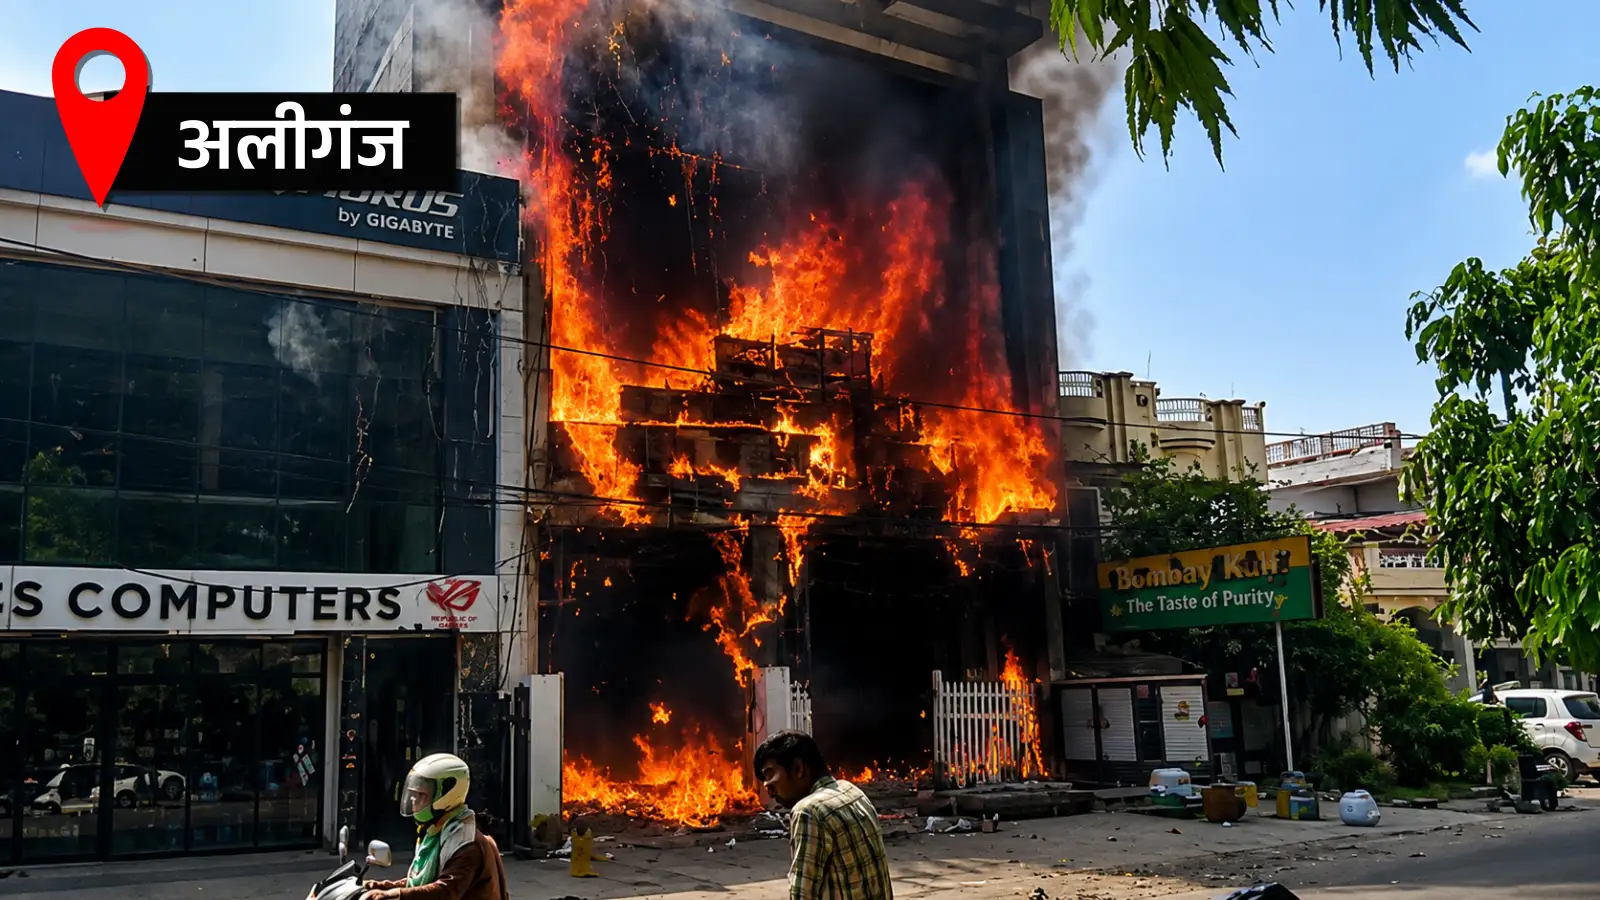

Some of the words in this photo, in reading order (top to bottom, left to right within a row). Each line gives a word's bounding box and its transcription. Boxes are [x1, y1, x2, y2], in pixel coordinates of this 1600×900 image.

[338, 207, 361, 227] by
[366, 213, 455, 239] GIGABYTE
[1116, 556, 1214, 590] Bombay
[0, 581, 43, 617] S
[68, 582, 402, 621] COMPUTERS
[1126, 597, 1154, 613] The
[1157, 595, 1198, 612] Taste
[1202, 591, 1219, 608] of
[1223, 587, 1275, 608] Purity
